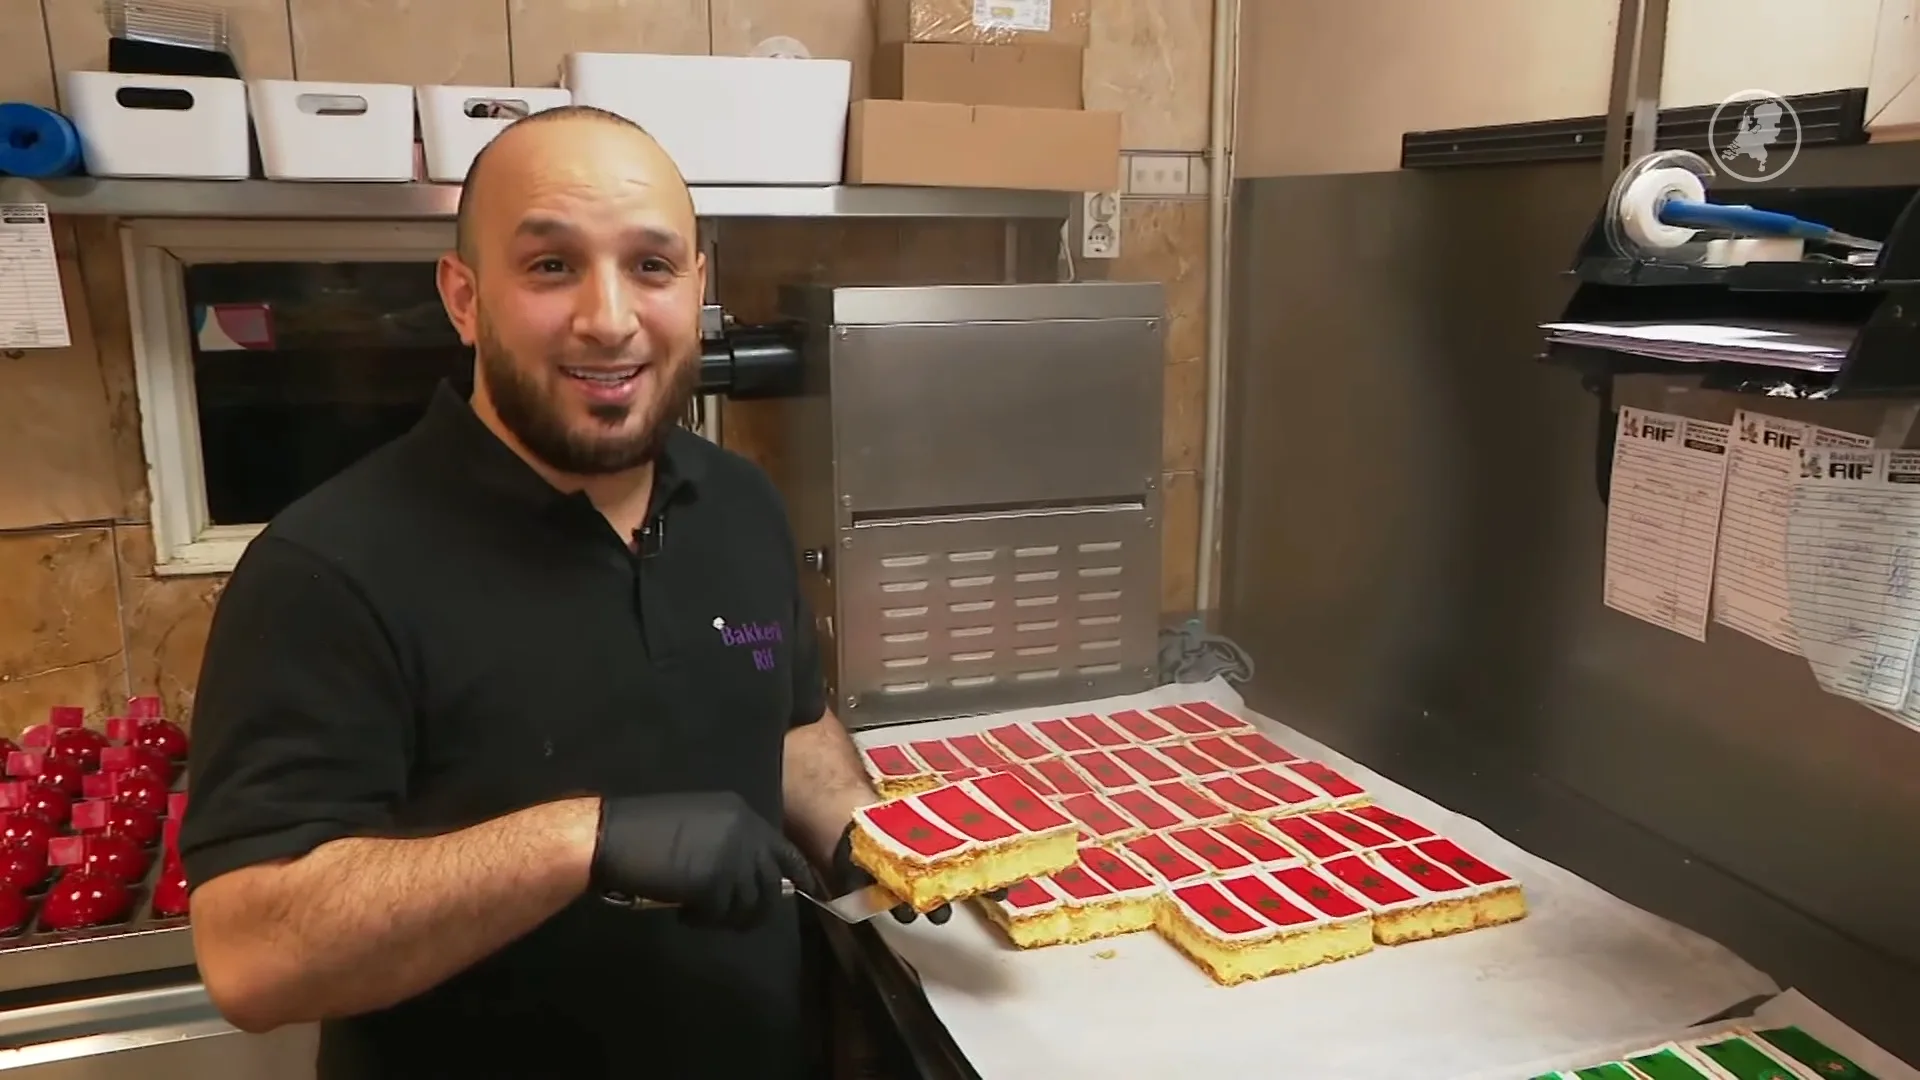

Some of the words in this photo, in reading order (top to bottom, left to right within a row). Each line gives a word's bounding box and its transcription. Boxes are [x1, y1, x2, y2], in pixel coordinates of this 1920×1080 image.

[1642, 425, 1675, 442] RIF
[1763, 430, 1801, 450] RIF
[1829, 463, 1873, 480] RIF
